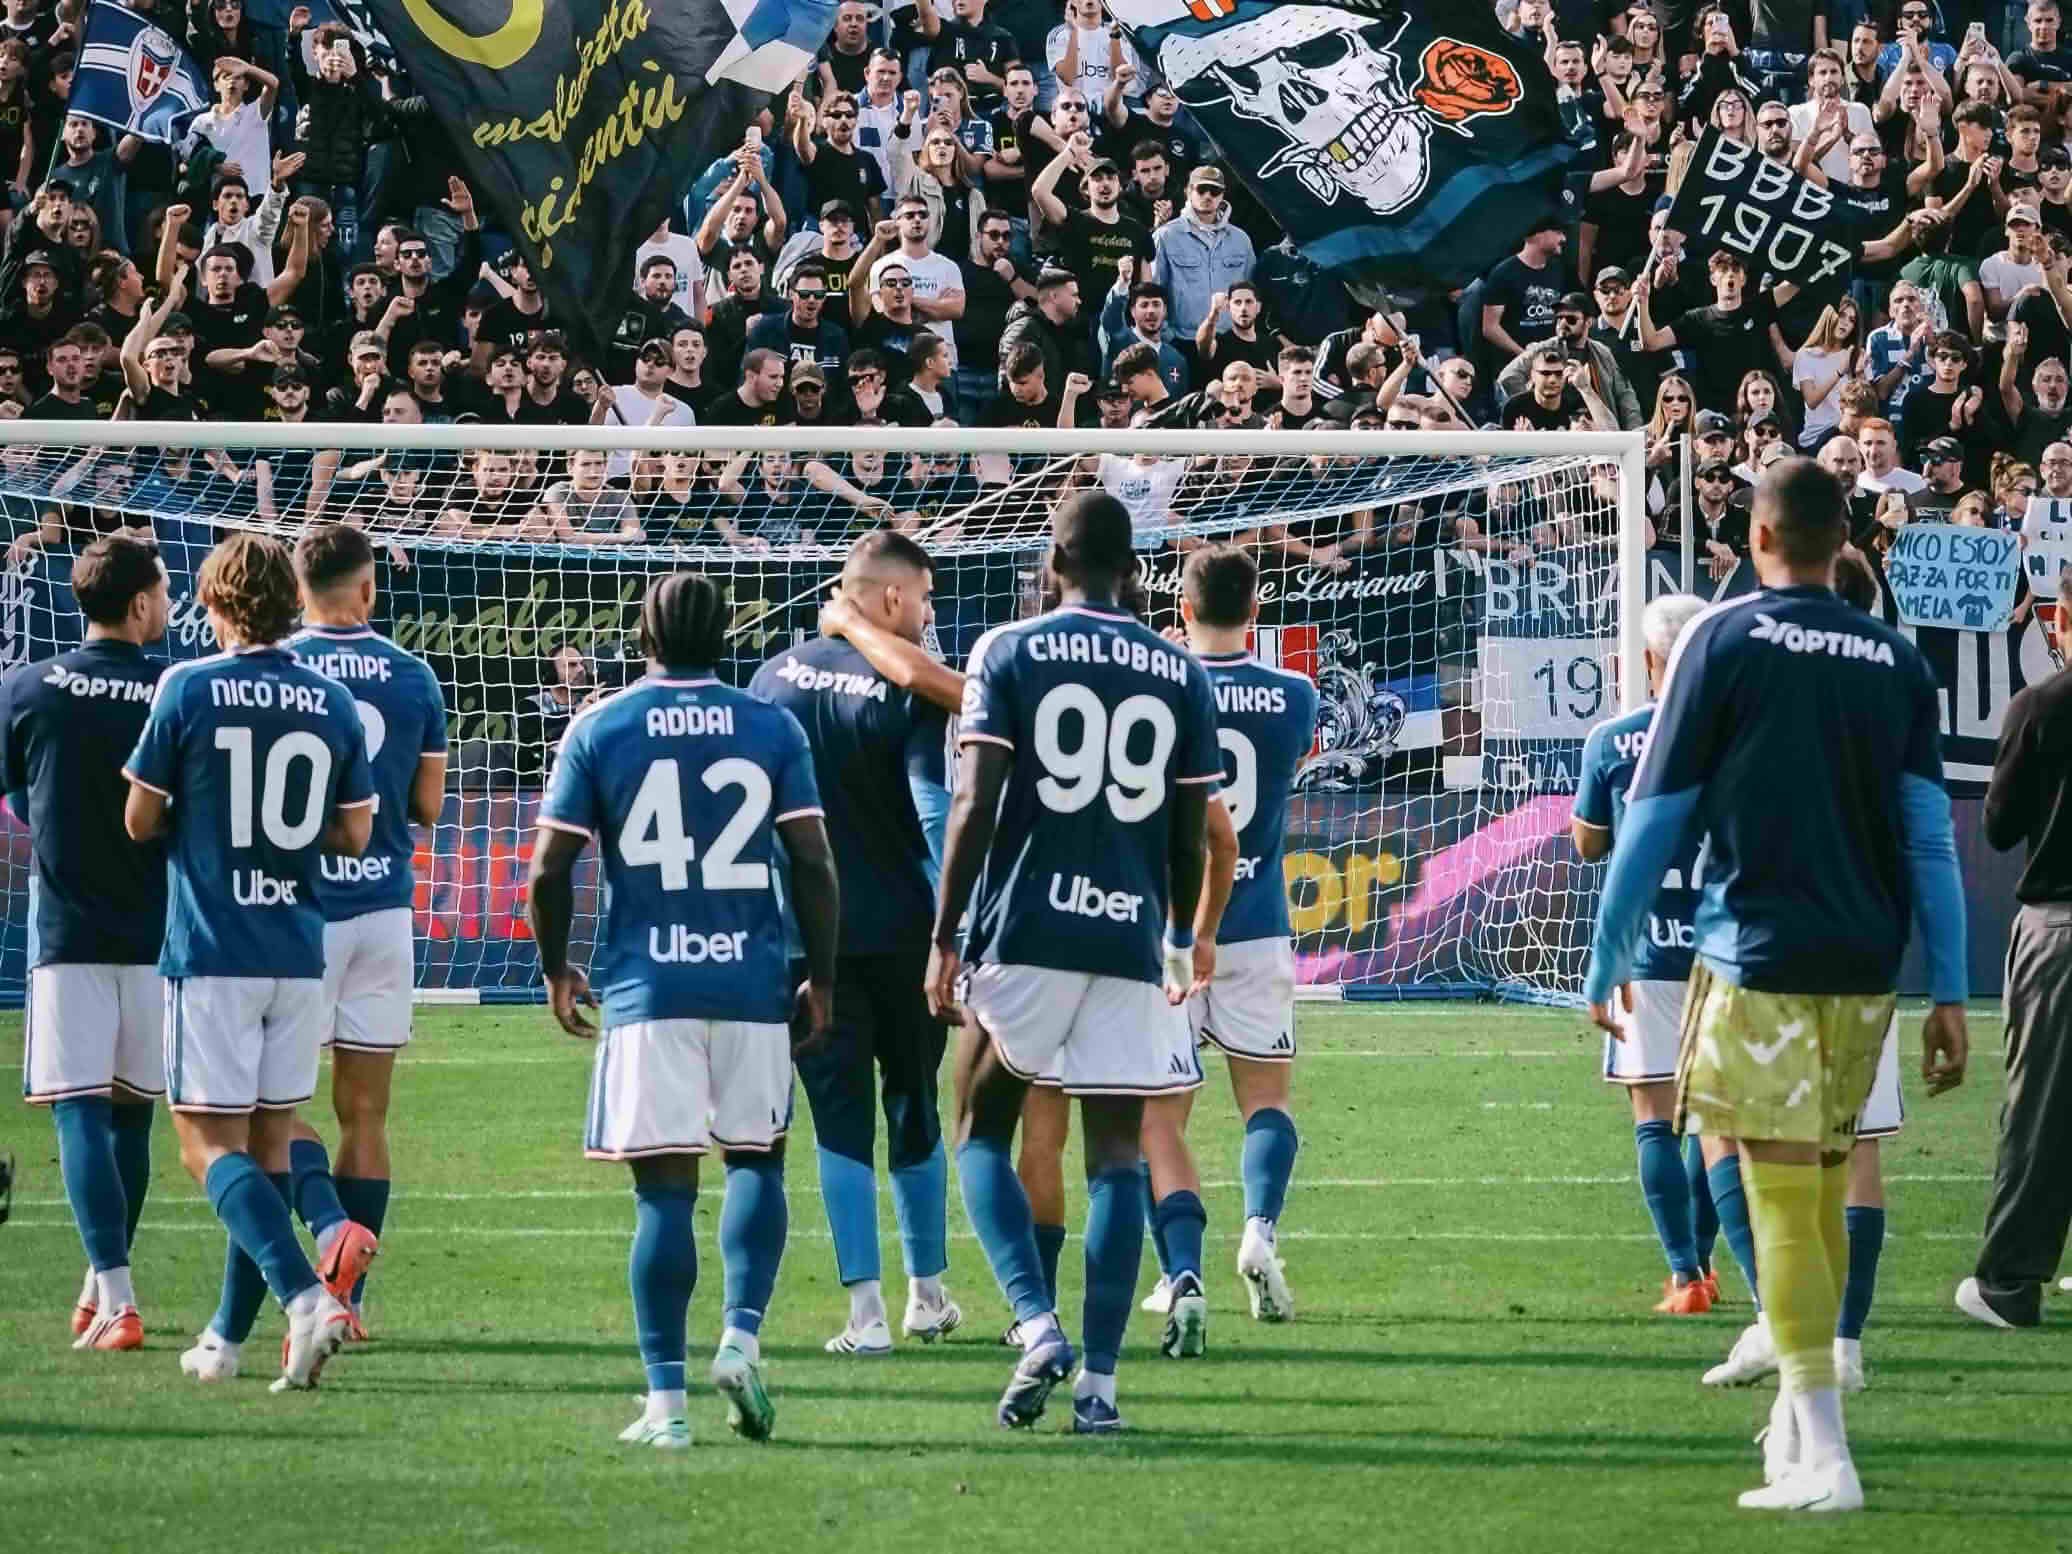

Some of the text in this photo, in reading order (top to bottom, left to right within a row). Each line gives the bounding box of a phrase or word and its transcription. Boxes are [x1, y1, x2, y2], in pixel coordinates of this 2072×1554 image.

[1705, 136, 1835, 220] BBB
[1700, 195, 1852, 283] 1907
[1949, 534, 2017, 565] ESTOY
[1286, 568, 1426, 601] Lariana
[1955, 567, 1990, 591] POR
[1994, 571, 2010, 590] TI
[1027, 630, 1189, 687] CHALOBAH
[1784, 627, 1895, 667] OPTIMA
[70, 677, 156, 705] OPTIM
[211, 677, 329, 716] NICO PAZ
[797, 669, 888, 703] OPTIMA
[647, 704, 734, 737] ADDAI
[1034, 683, 1177, 823] 99
[214, 726, 333, 850] 10
[618, 757, 772, 891] 42
[319, 853, 392, 883] Uber
[1048, 872, 1143, 924] Uber
[648, 925, 748, 963] Uber
